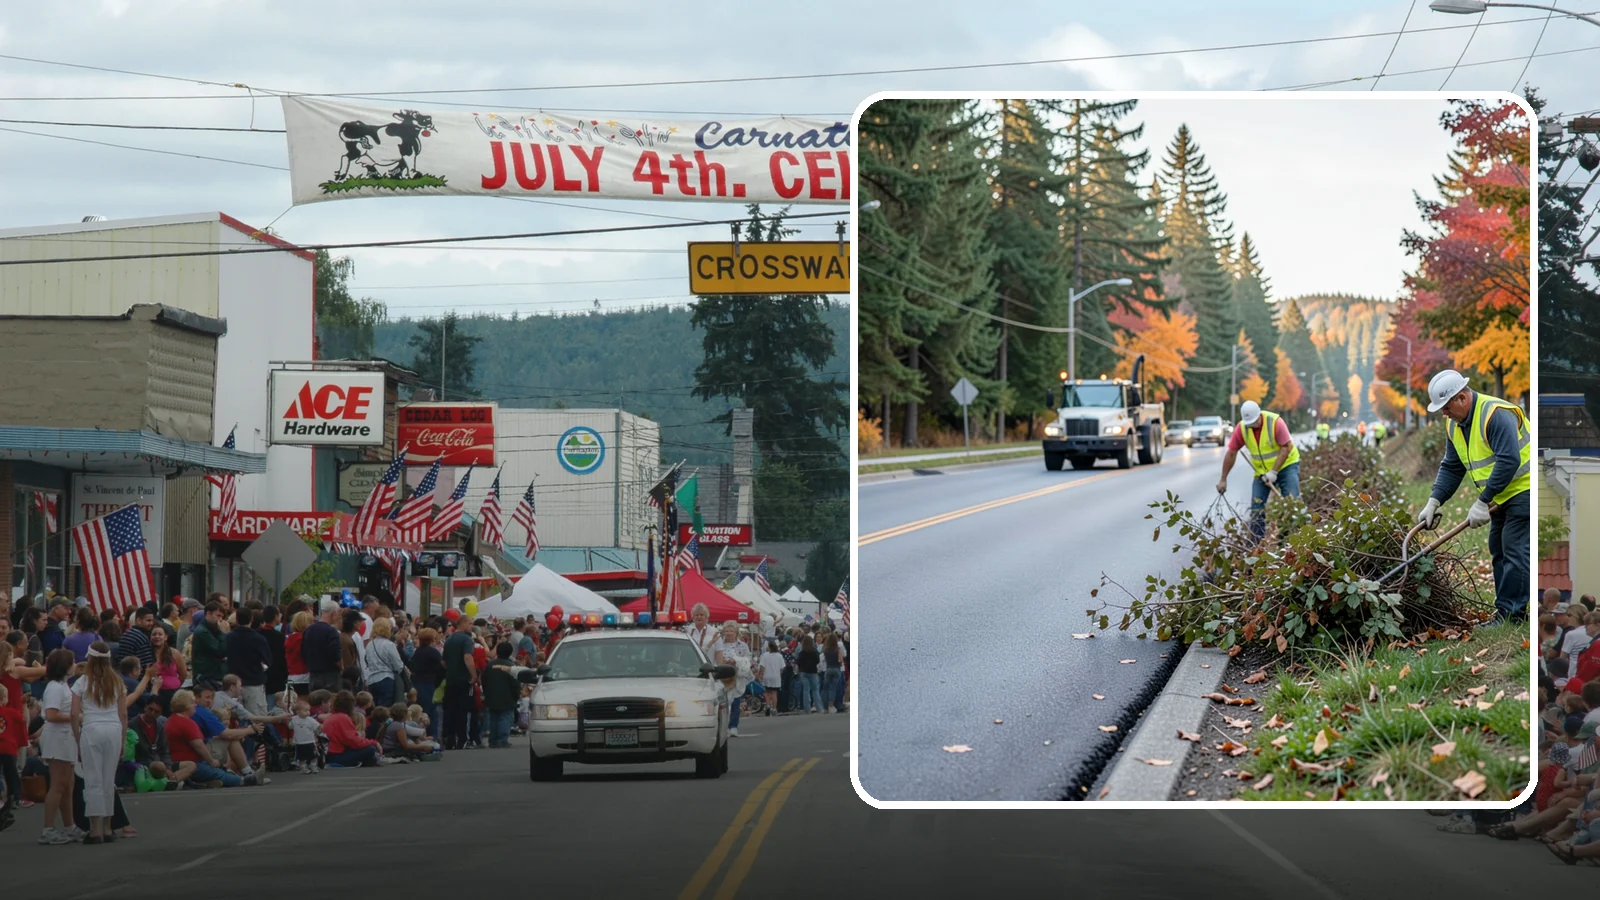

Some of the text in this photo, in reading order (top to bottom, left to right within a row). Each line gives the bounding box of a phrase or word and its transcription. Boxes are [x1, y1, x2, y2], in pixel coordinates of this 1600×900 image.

[481, 141, 604, 192] JULY
[632, 150, 746, 197] 4th.
[697, 253, 850, 280] CROSSWA
[283, 380, 373, 420] ACE
[406, 409, 453, 422] CEDAR
[283, 421, 371, 436] Hardware
[416, 428, 477, 447] Coca-Cola
[353, 467, 386, 480] Simpl
[83, 485, 155, 495] St. Vincent de Paul
[688, 526, 741, 535] CRNATION
[699, 535, 730, 543] GLASS
